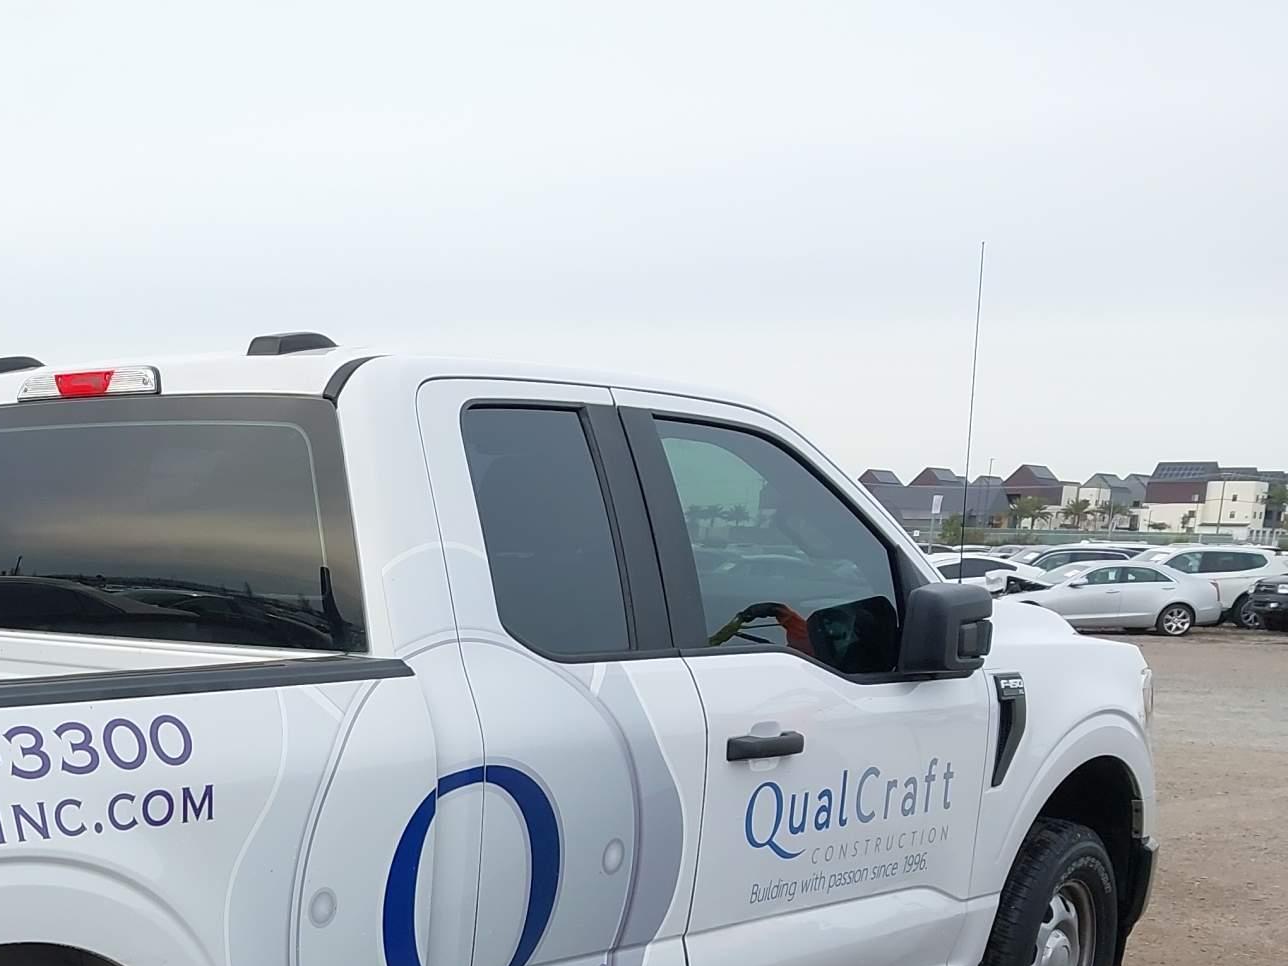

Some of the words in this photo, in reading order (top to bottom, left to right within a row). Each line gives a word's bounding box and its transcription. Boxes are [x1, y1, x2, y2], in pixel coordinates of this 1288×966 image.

[745, 758, 954, 860] QualCraft
[811, 826, 950, 864] CONSTRUCTION
[750, 881, 797, 905] Building
[801, 871, 826, 894] with
[827, 867, 869, 894] passion
[870, 862, 899, 881] since
[902, 852, 929, 874] 1996.
